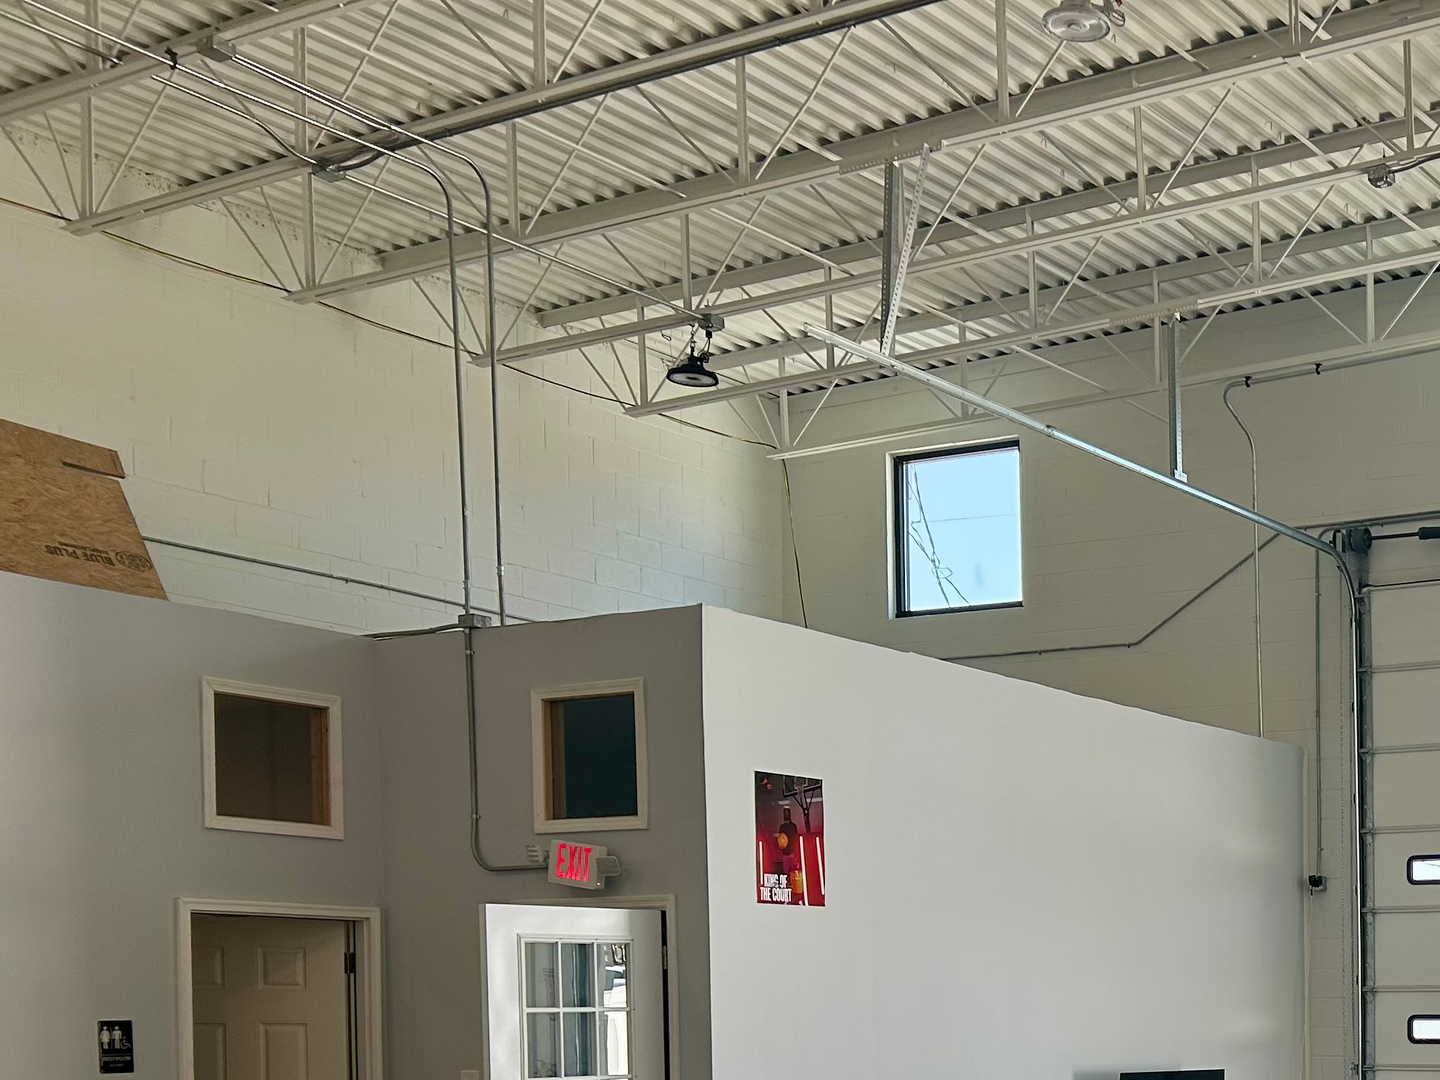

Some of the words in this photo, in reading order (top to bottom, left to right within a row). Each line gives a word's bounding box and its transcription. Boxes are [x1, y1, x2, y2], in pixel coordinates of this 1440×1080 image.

[45, 544, 81, 560] PLUS
[82, 551, 115, 567] BLUE
[556, 843, 593, 882] EXIT
[763, 873, 779, 888] KING
[779, 874, 788, 888] OF
[760, 886, 772, 902] THE
[772, 887, 792, 902] COURT
